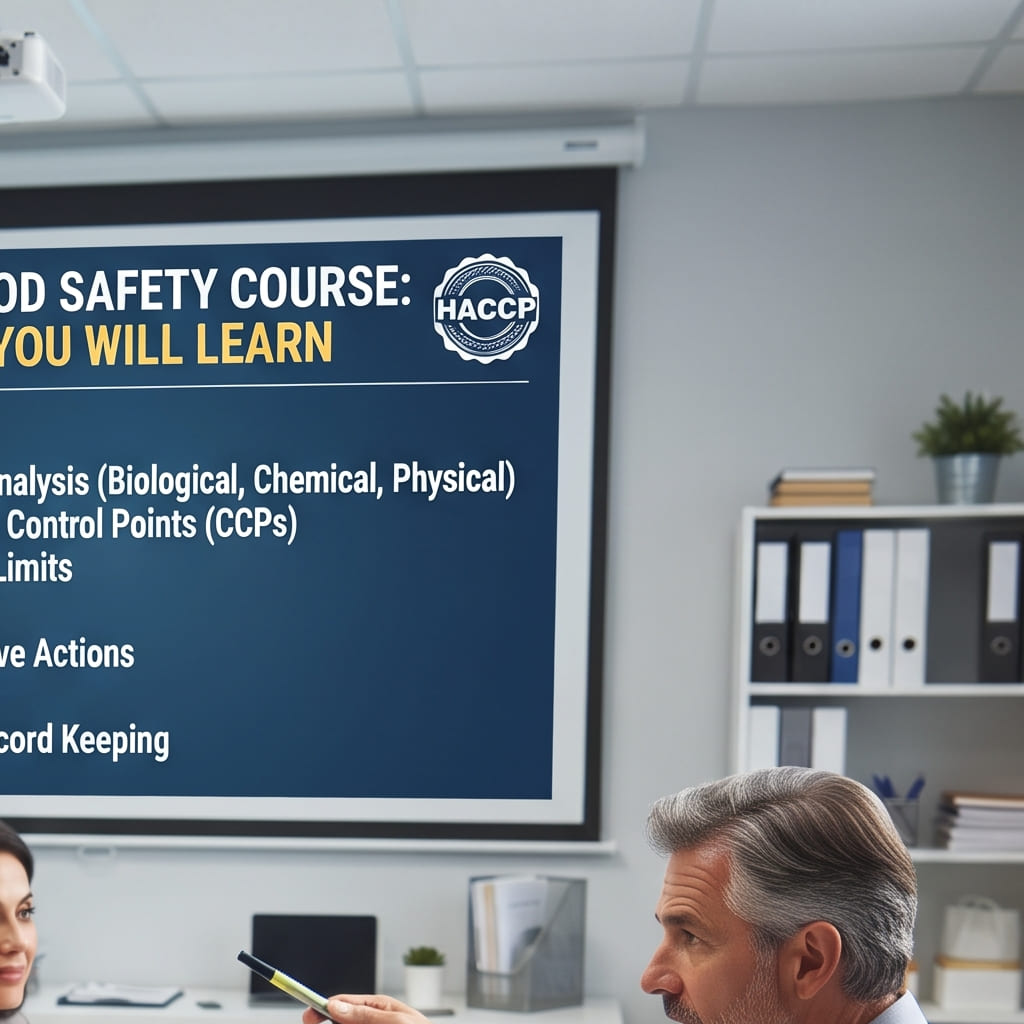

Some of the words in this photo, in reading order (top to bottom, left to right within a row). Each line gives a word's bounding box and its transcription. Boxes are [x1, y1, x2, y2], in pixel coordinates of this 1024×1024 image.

[59, 269, 219, 312] SAFETY
[230, 265, 411, 309] COURSE:
[437, 297, 537, 321] HACCP
[84, 323, 184, 366] WILL
[197, 321, 332, 365] LEARN
[97, 463, 245, 504] (Biological,
[253, 461, 383, 500] Chemical,
[393, 460, 515, 502] Physical)
[7, 507, 103, 540] Control
[112, 506, 197, 539] Points
[205, 505, 297, 545] (CCPs)
[32, 636, 135, 668] Actions
[62, 722, 169, 763] Keeping
